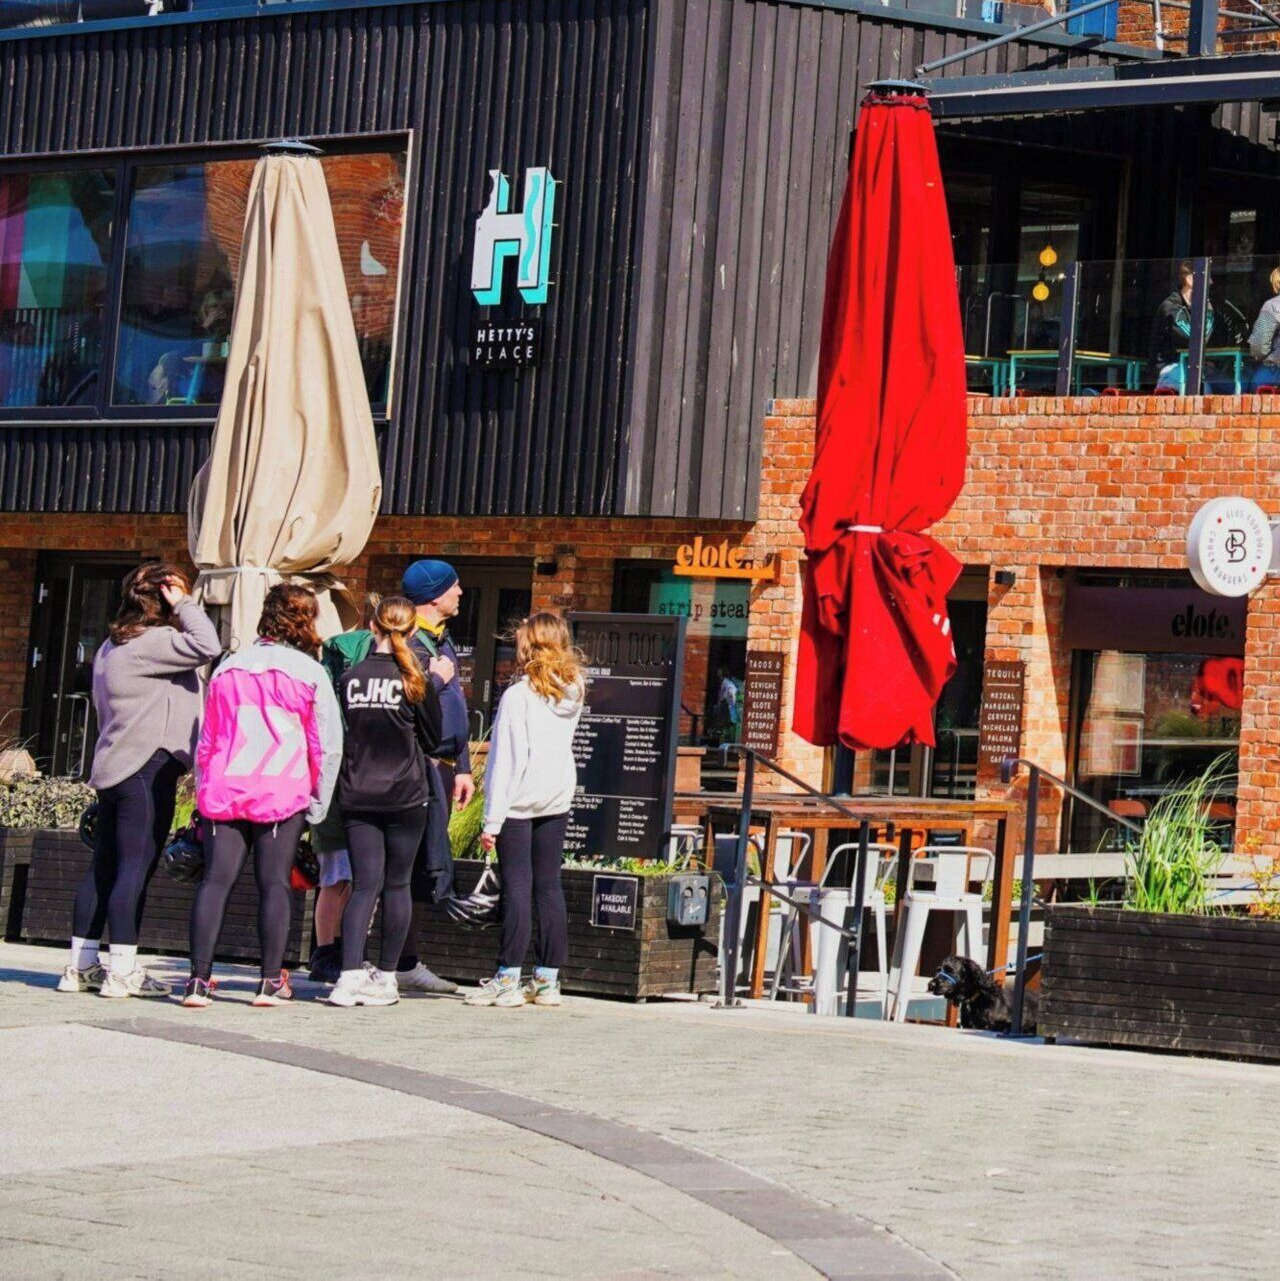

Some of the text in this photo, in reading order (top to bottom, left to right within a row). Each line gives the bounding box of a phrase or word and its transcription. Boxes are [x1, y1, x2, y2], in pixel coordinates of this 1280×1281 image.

[477, 327, 534, 343] HETTY'S
[476, 346, 533, 360] PLACE
[658, 599, 703, 621] strip
[749, 660, 772, 669] TACOS
[987, 669, 1021, 679] TEQUILA
[347, 678, 402, 704] CJHC
[748, 691, 778, 699] TOSTADAS
[990, 692, 1015, 700] MEZCAL
[984, 702, 1020, 711] MARGARITA
[987, 713, 1016, 721] CERVEZA
[983, 724, 1019, 732] MICHELADA
[748, 731, 771, 740] BRUNCH
[987, 734, 1013, 742] PALOMA
[601, 893, 628, 903] TAKEOUT
[600, 903, 632, 914] AVAILABLE
